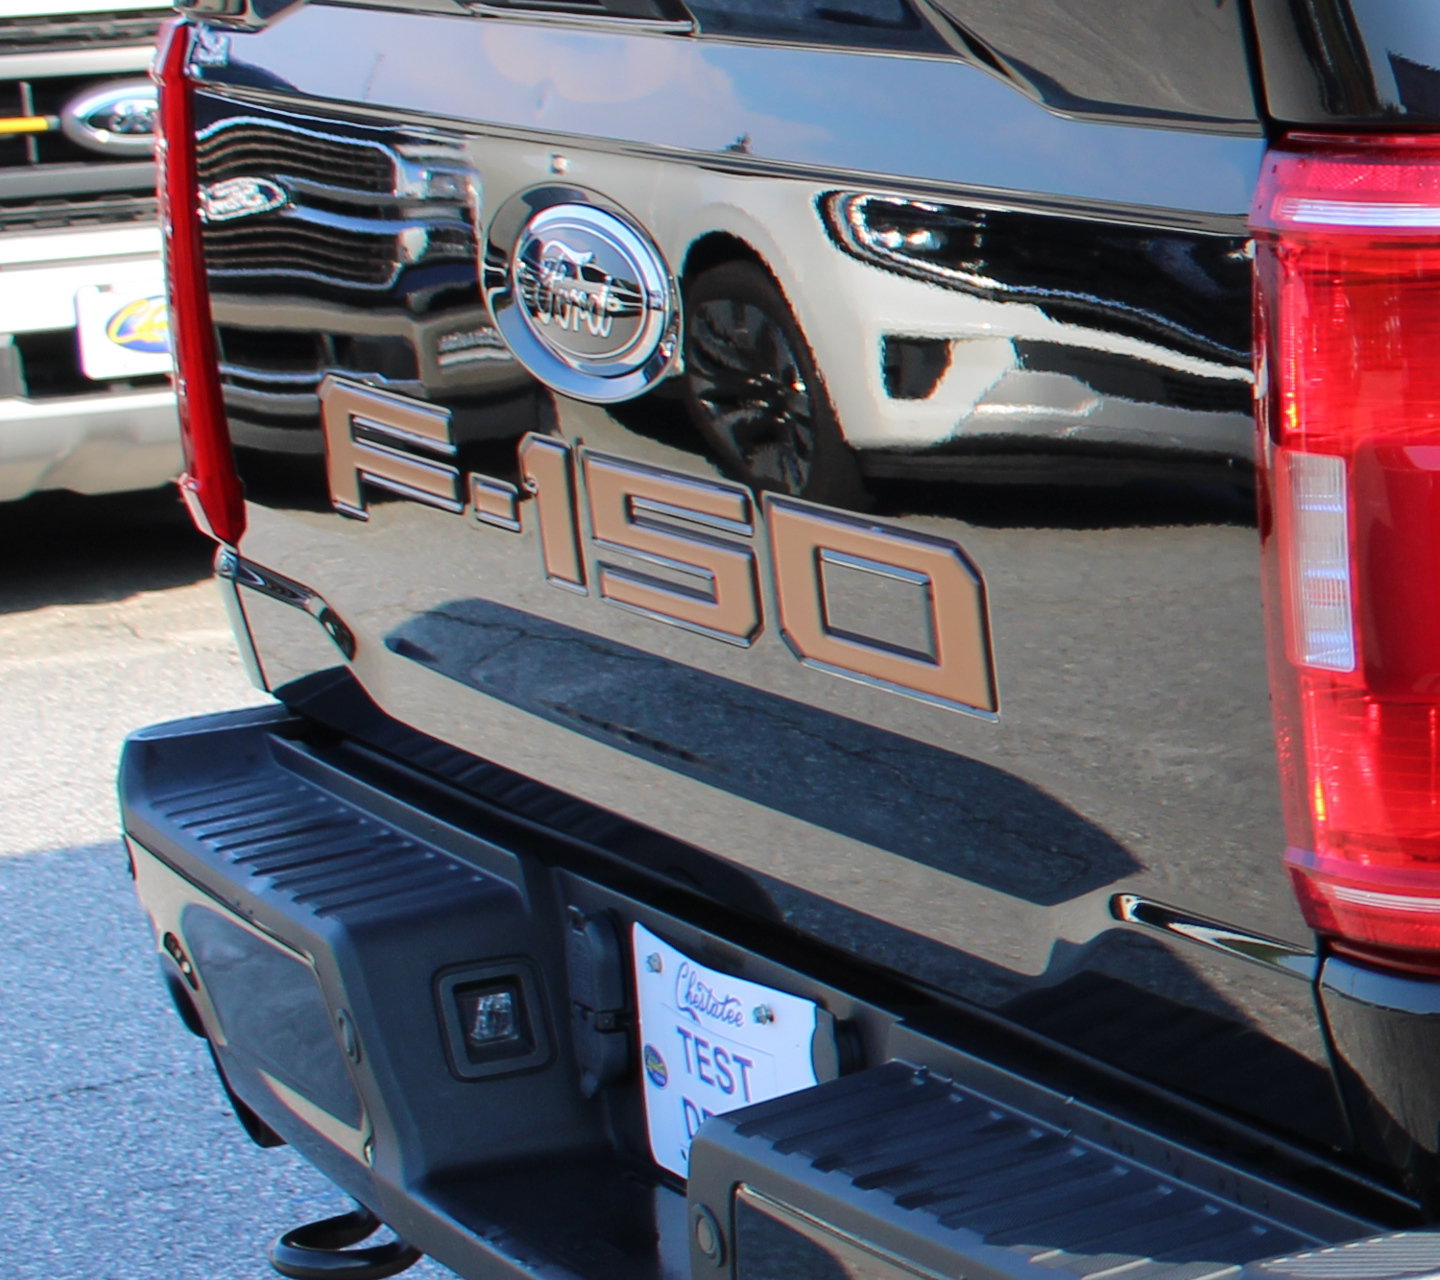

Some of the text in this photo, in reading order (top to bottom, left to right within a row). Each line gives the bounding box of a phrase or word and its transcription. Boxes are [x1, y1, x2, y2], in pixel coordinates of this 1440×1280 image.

[536, 240, 613, 338] Ford
[317, 373, 1000, 723] F-150
[676, 1025, 753, 1103] TEST
